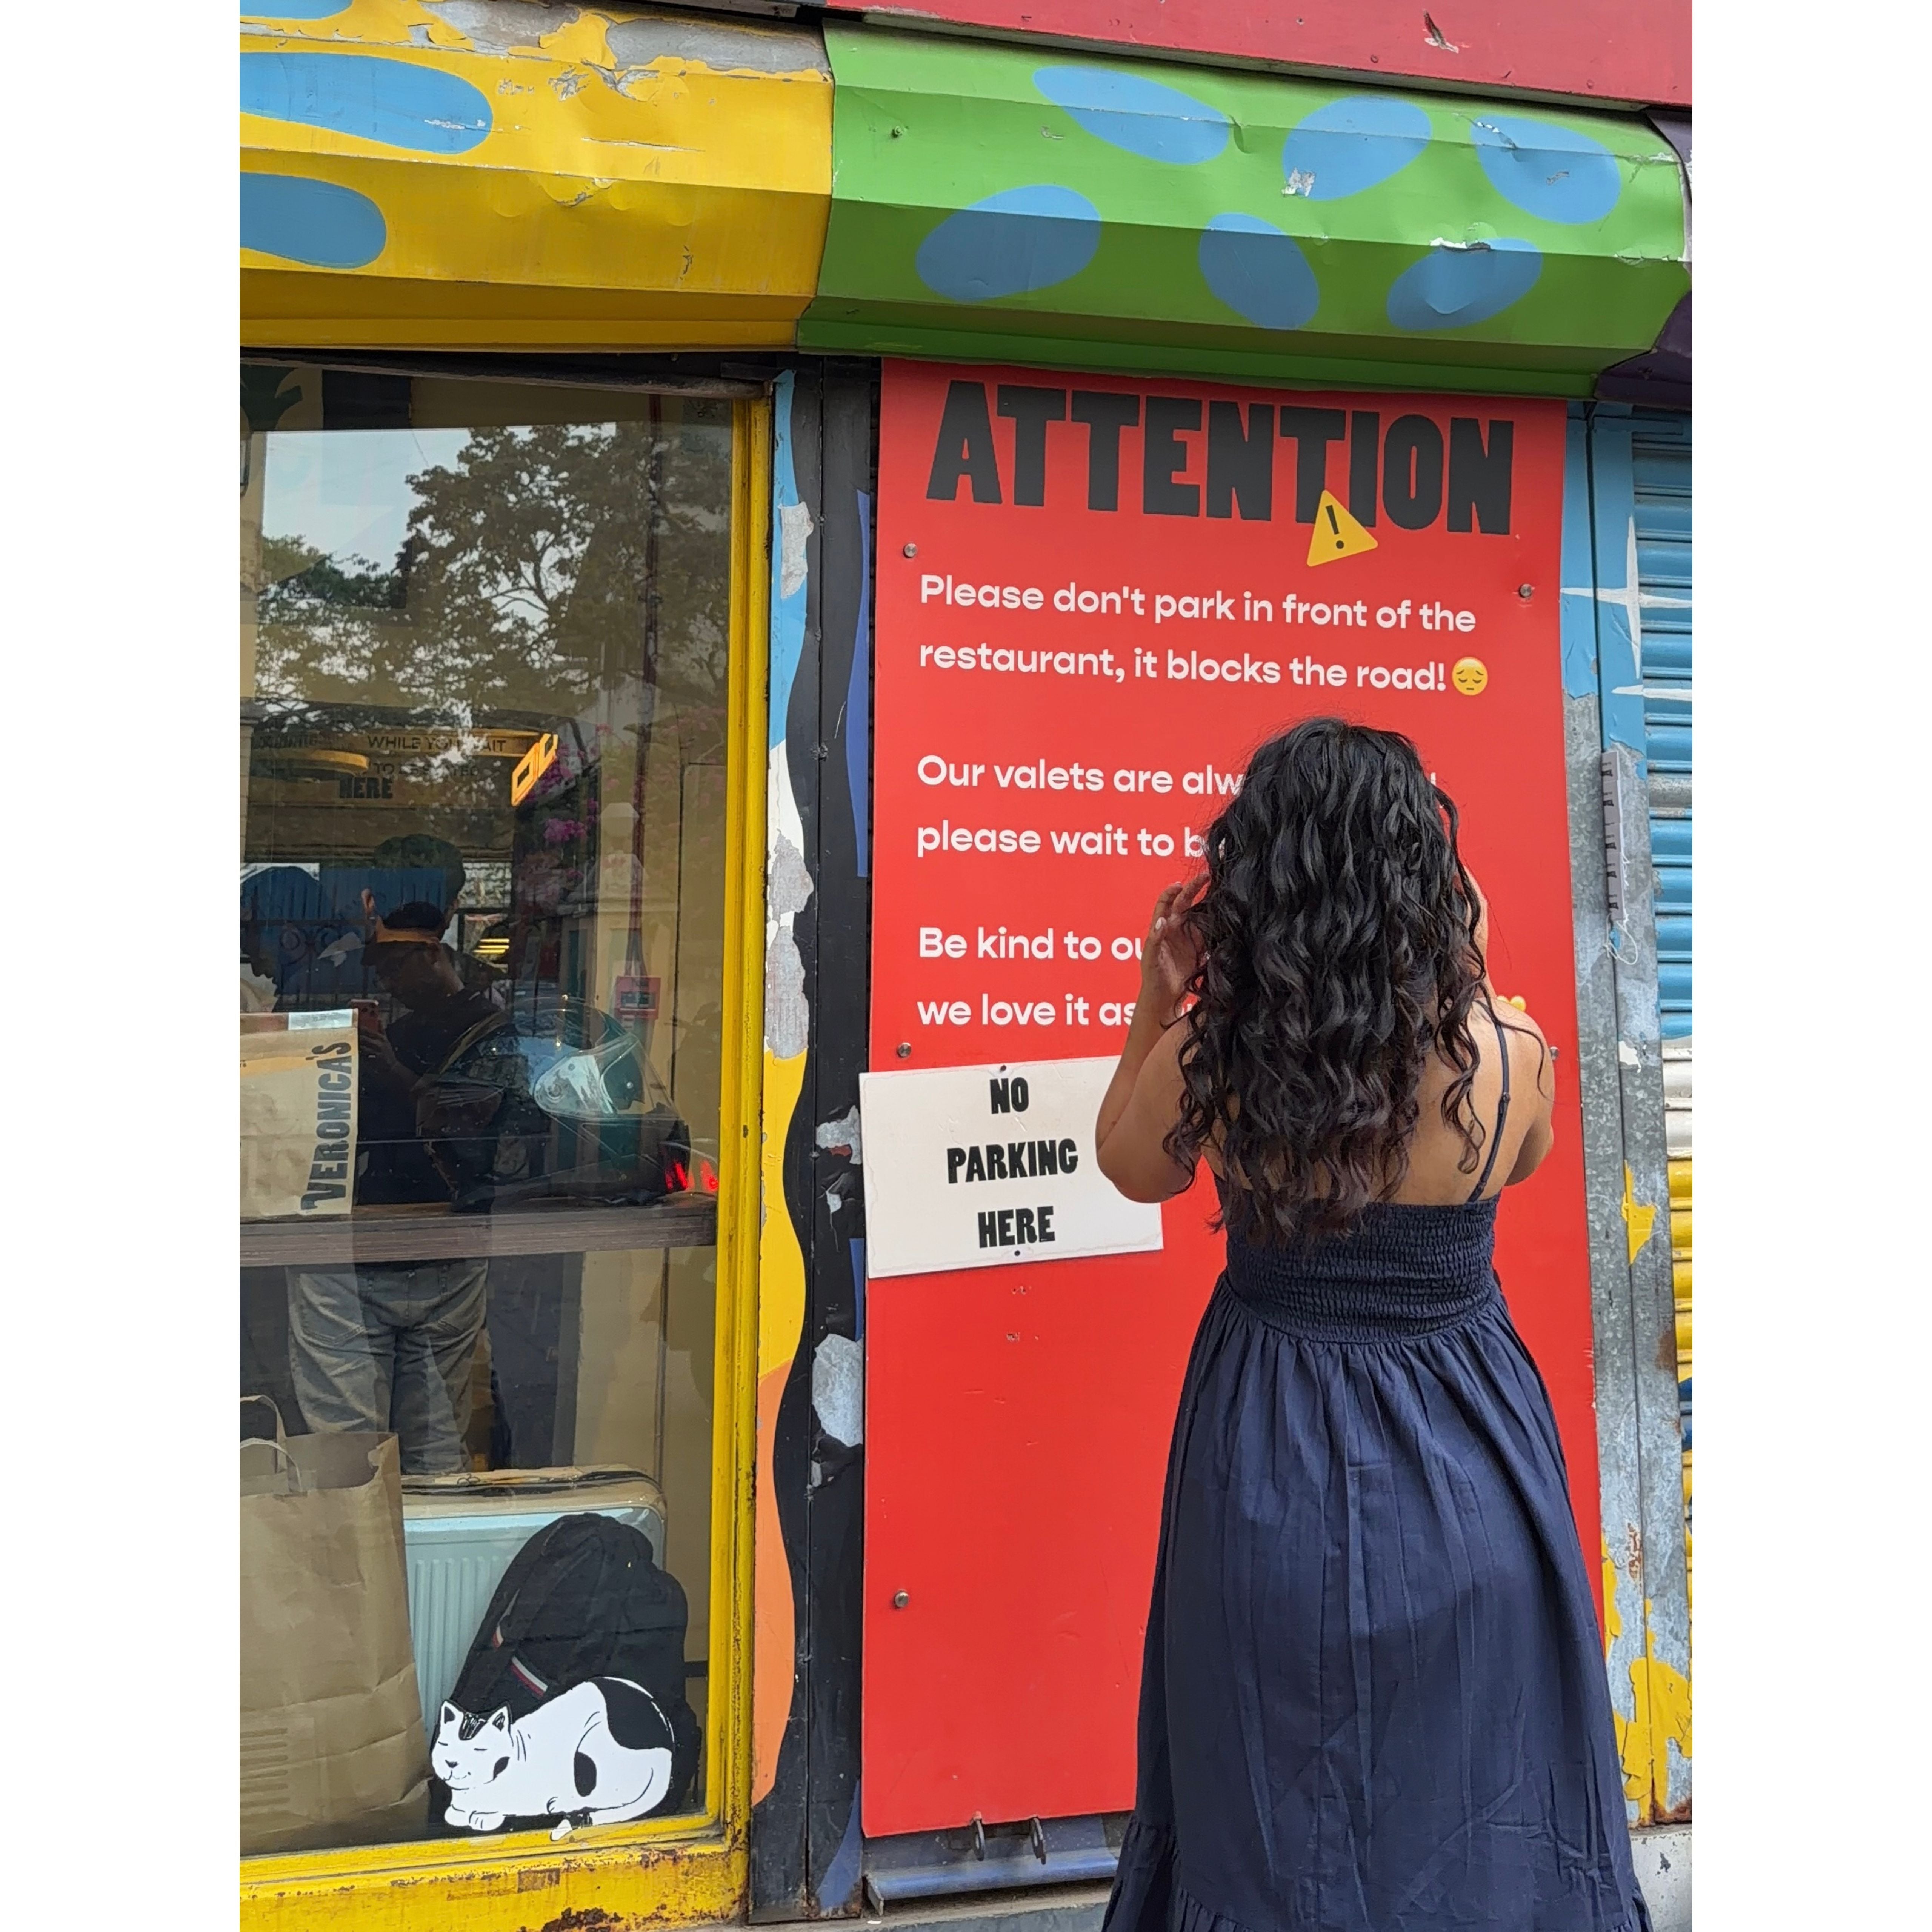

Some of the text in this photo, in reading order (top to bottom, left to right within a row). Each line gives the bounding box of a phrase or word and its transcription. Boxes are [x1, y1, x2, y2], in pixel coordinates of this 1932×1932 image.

[926, 380, 1514, 535] ATTENTION
[921, 574, 1476, 633] Please don't park in front of the
[920, 642, 1446, 691] restaurant, it blocks the road!
[368, 736, 421, 749] WHILE
[466, 740, 506, 752] AIT
[340, 775, 393, 799] HERE
[917, 754, 1244, 796] Our valets are alw
[917, 819, 1041, 858] please
[1049, 823, 1129, 856] wait
[1136, 828, 1175, 857] to
[919, 926, 968, 959] Be
[977, 926, 1054, 960] kind
[1063, 931, 1102, 961] to
[917, 1001, 972, 1026] we
[981, 993, 1056, 1026] love
[1064, 993, 1090, 1026] it
[989, 1077, 1029, 1114] NO
[300, 1041, 352, 1210] VERONICA'S
[947, 1138, 1078, 1184] PARKING
[977, 1206, 1055, 1249] HERE
